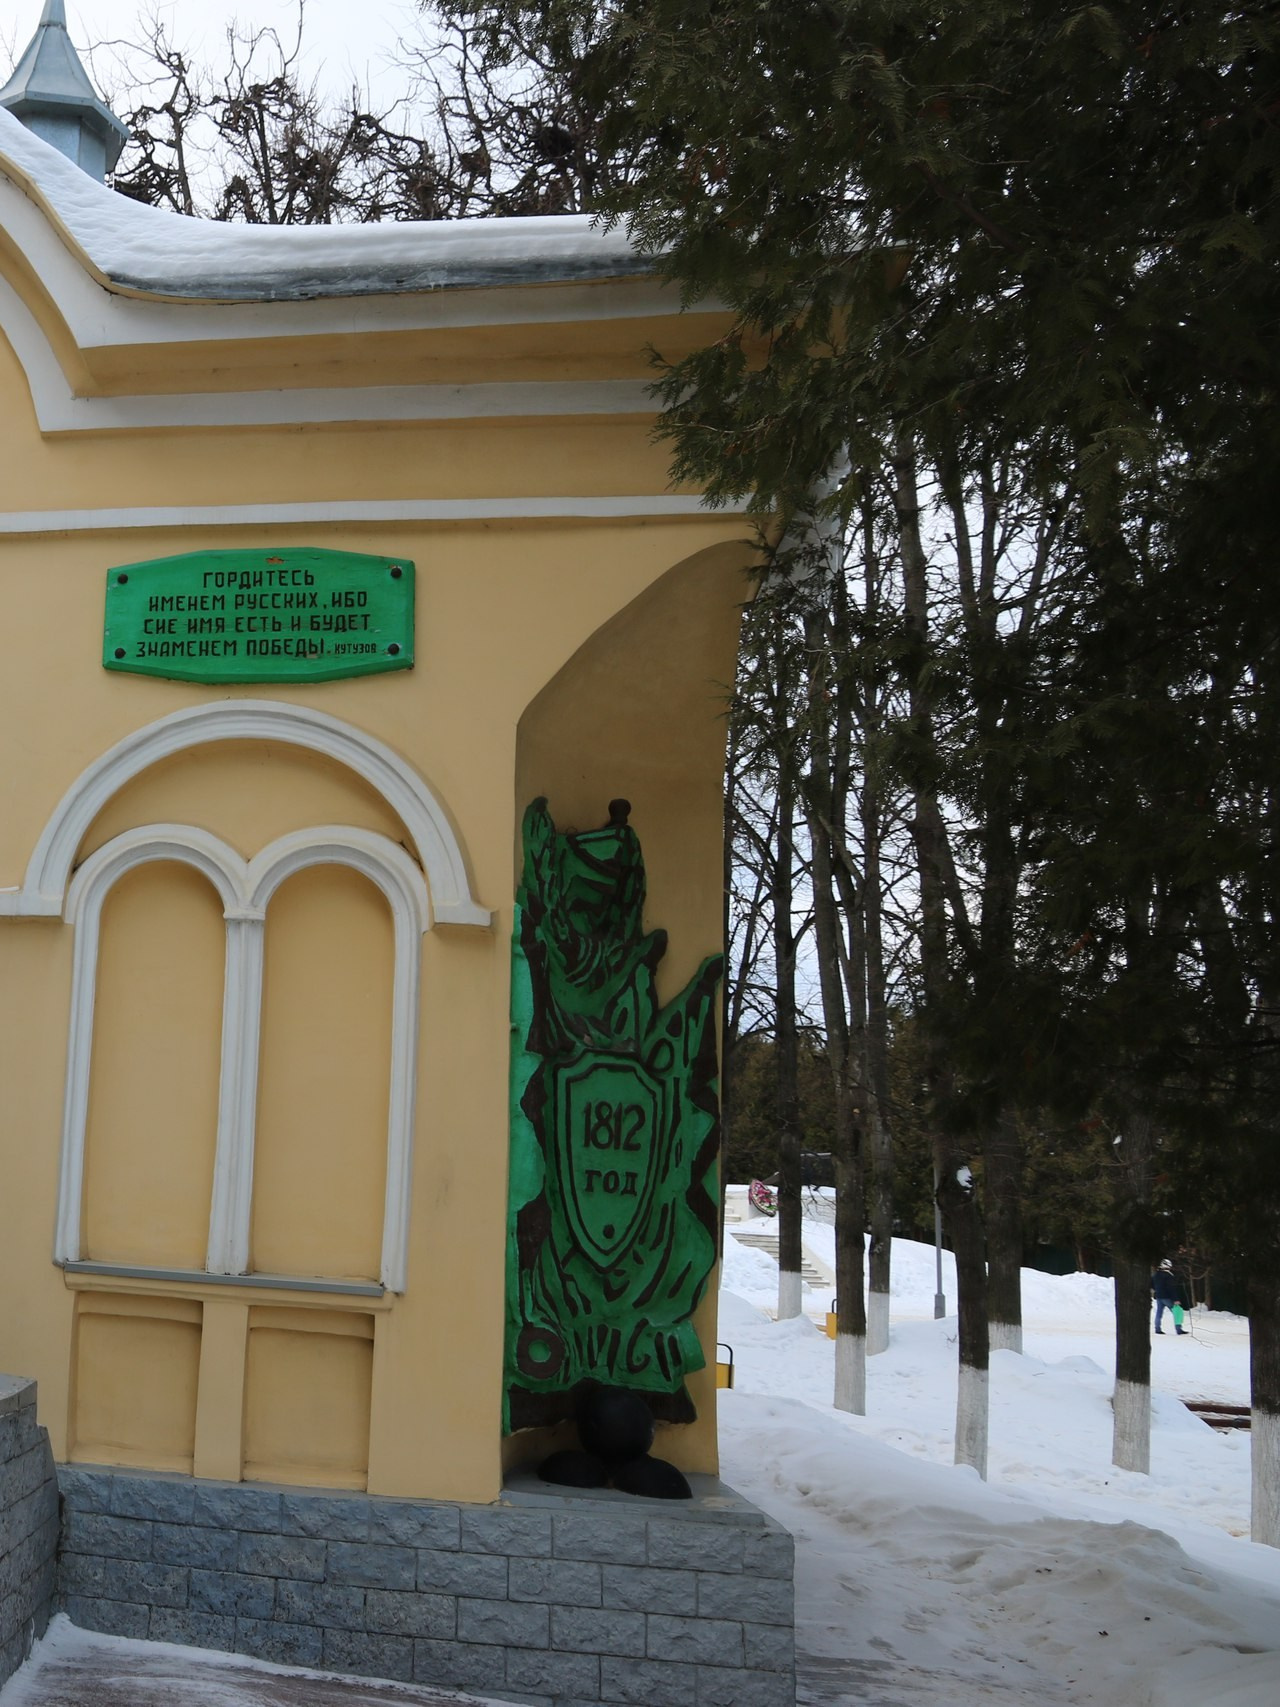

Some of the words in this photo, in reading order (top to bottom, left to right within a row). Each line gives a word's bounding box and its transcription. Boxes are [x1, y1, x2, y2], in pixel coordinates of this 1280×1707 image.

[202, 569, 315, 590] ГОРДИТЕСЬ
[148, 593, 226, 612] ИМЕНЕМ
[234, 591, 327, 611] РУССКИХ,
[331, 591, 368, 608] ИБО
[143, 618, 178, 634] СИЕ
[186, 617, 226, 634] ИМЯ
[234, 615, 282, 633] ЕСТЬ
[290, 615, 301, 632] И
[309, 613, 371, 633] БУДЕТ
[135, 639, 237, 658] ЗНАМЕНЕМ
[246, 637, 331, 658] ПОБЕДЫ.
[334, 642, 377, 654] КУТУЗОВ
[582, 1100, 646, 1151] 1812
